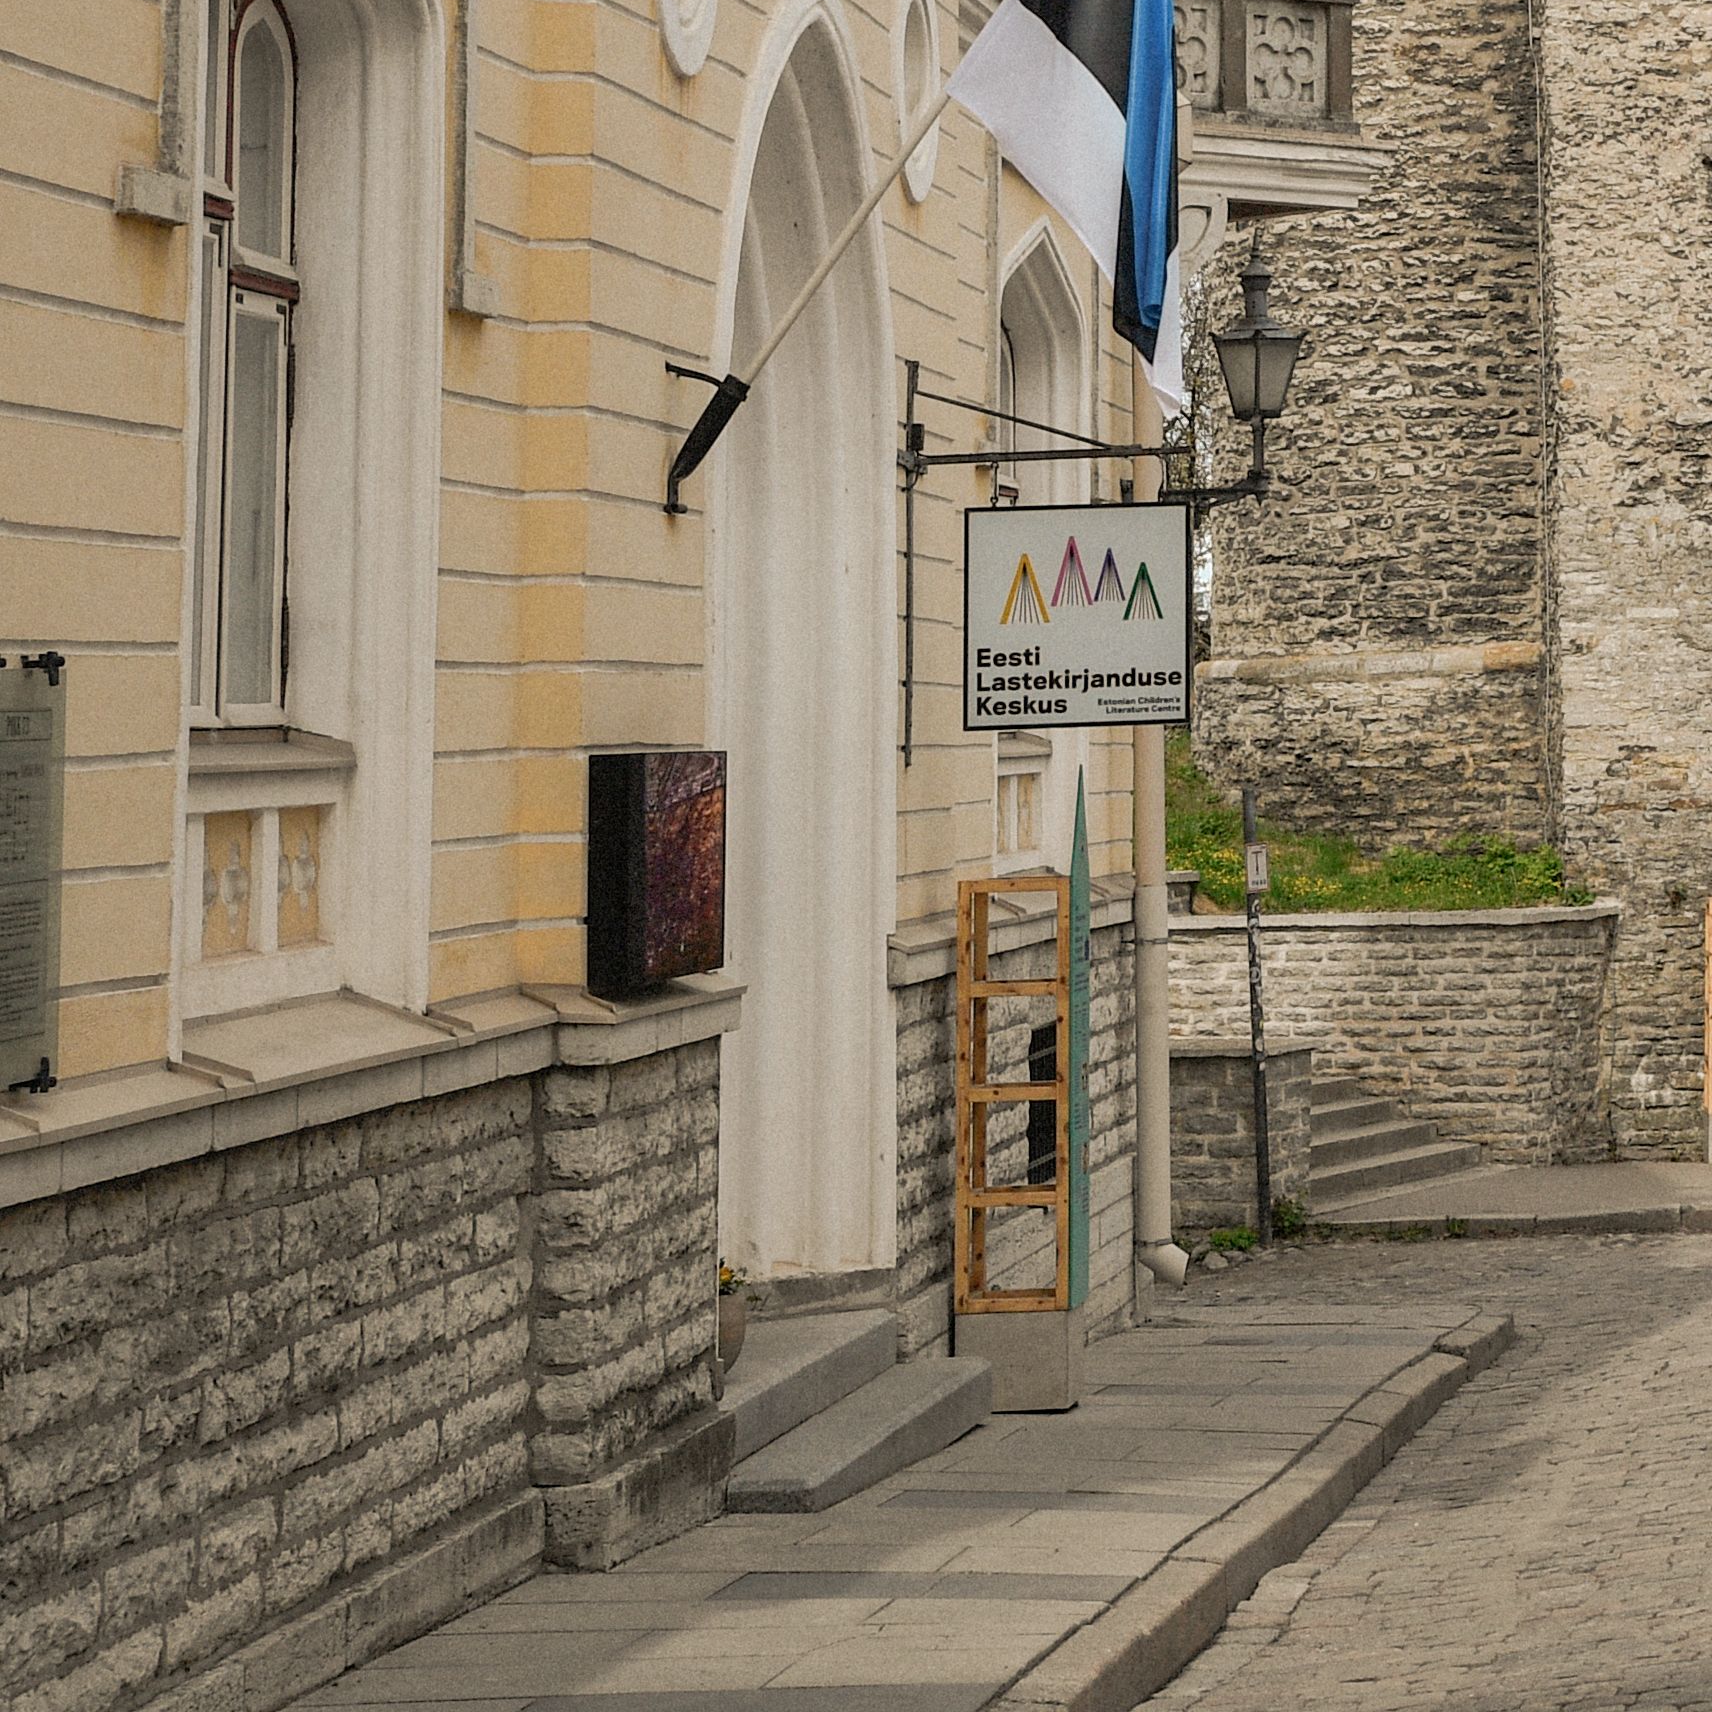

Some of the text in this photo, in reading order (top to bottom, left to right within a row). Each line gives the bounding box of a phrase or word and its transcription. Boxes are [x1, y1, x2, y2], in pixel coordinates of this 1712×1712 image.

[977, 646, 1041, 667] Eesti
[977, 668, 1182, 693] Lastekirjanduse
[976, 695, 1068, 716] Keskus
[1097, 696, 1181, 706] Estonian Children's
[1105, 704, 1181, 714] Literature Centre
